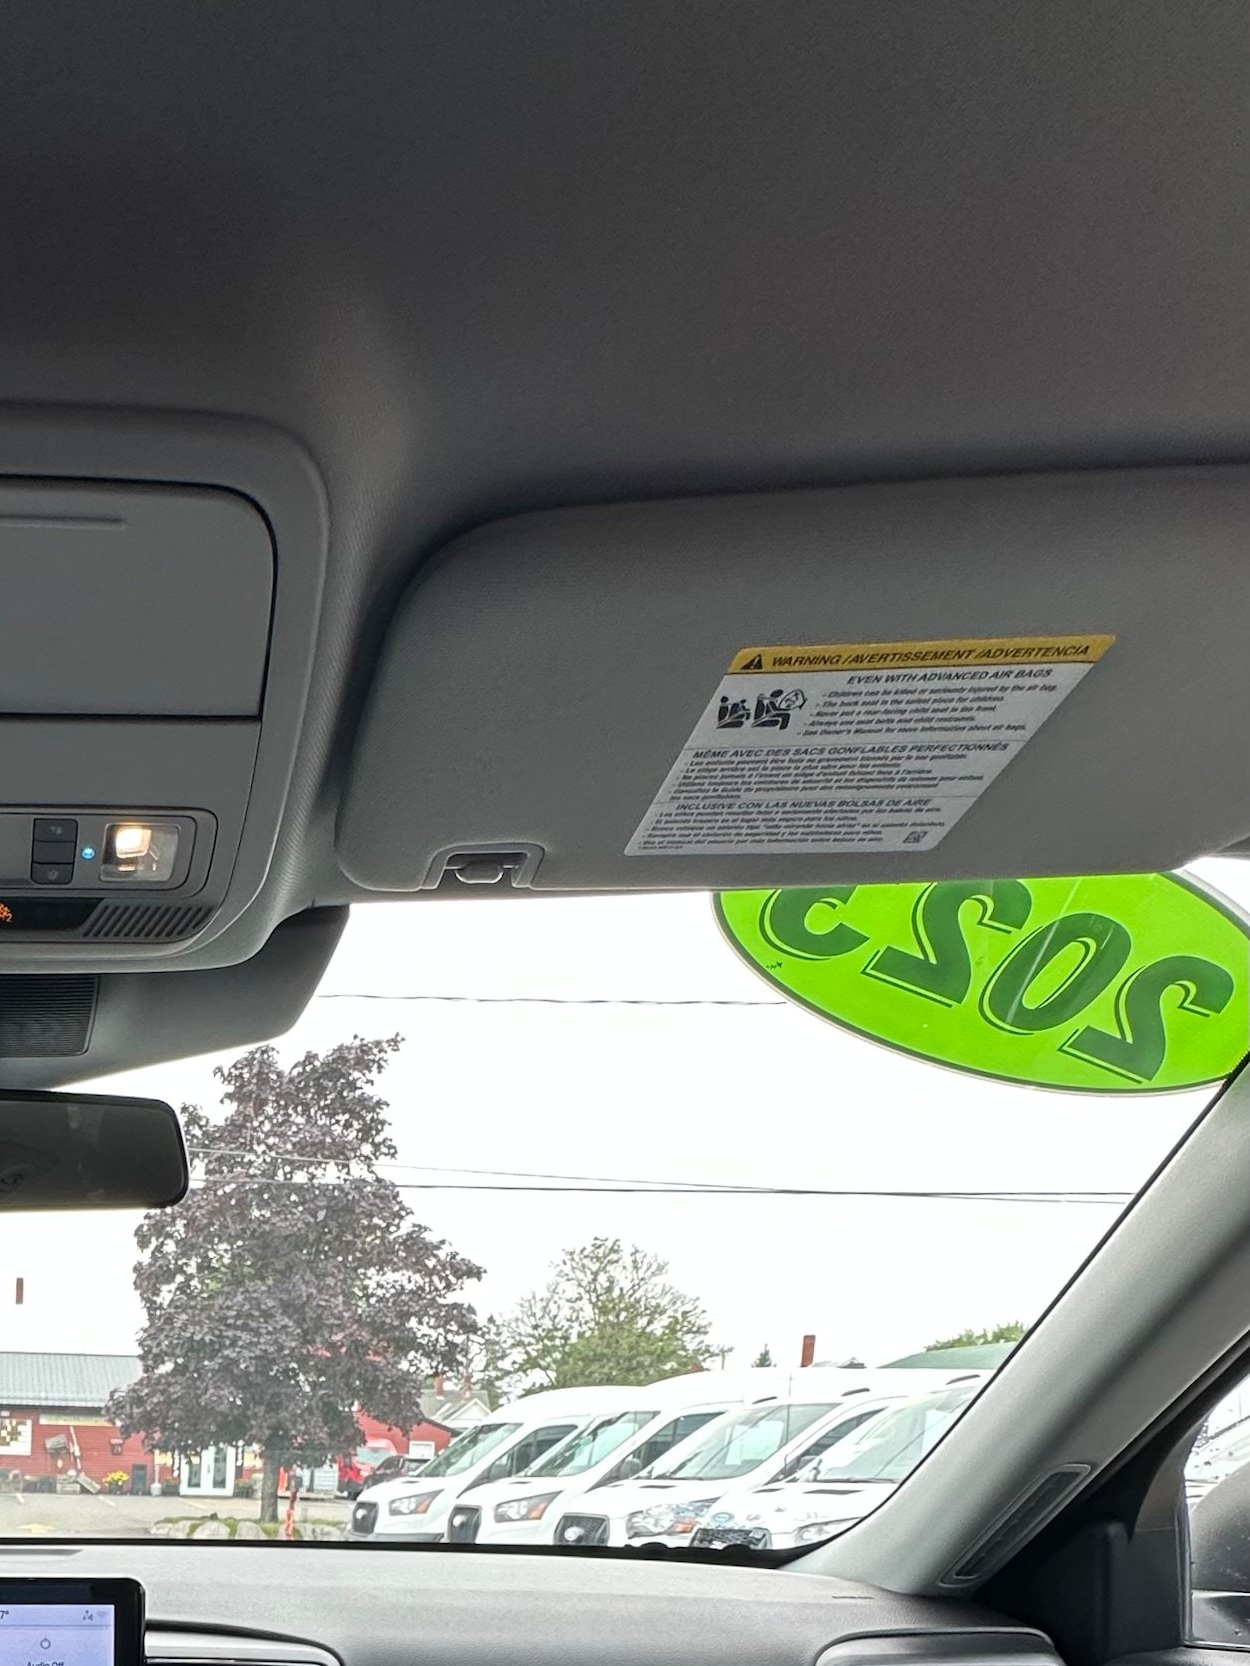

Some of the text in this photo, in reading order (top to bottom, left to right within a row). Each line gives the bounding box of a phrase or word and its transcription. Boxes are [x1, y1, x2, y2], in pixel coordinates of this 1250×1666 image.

[772, 653, 841, 667] WARNING
[846, 669, 1053, 684] EVEN WITH ADVANCED AIR BAGS
[730, 749, 764, 758] AVEC
[765, 748, 790, 757] DES
[792, 747, 827, 756] SACS
[676, 802, 736, 811] INCLUSIVE
[765, 801, 788, 809] LAS
[789, 800, 836, 808] NUEVAS
